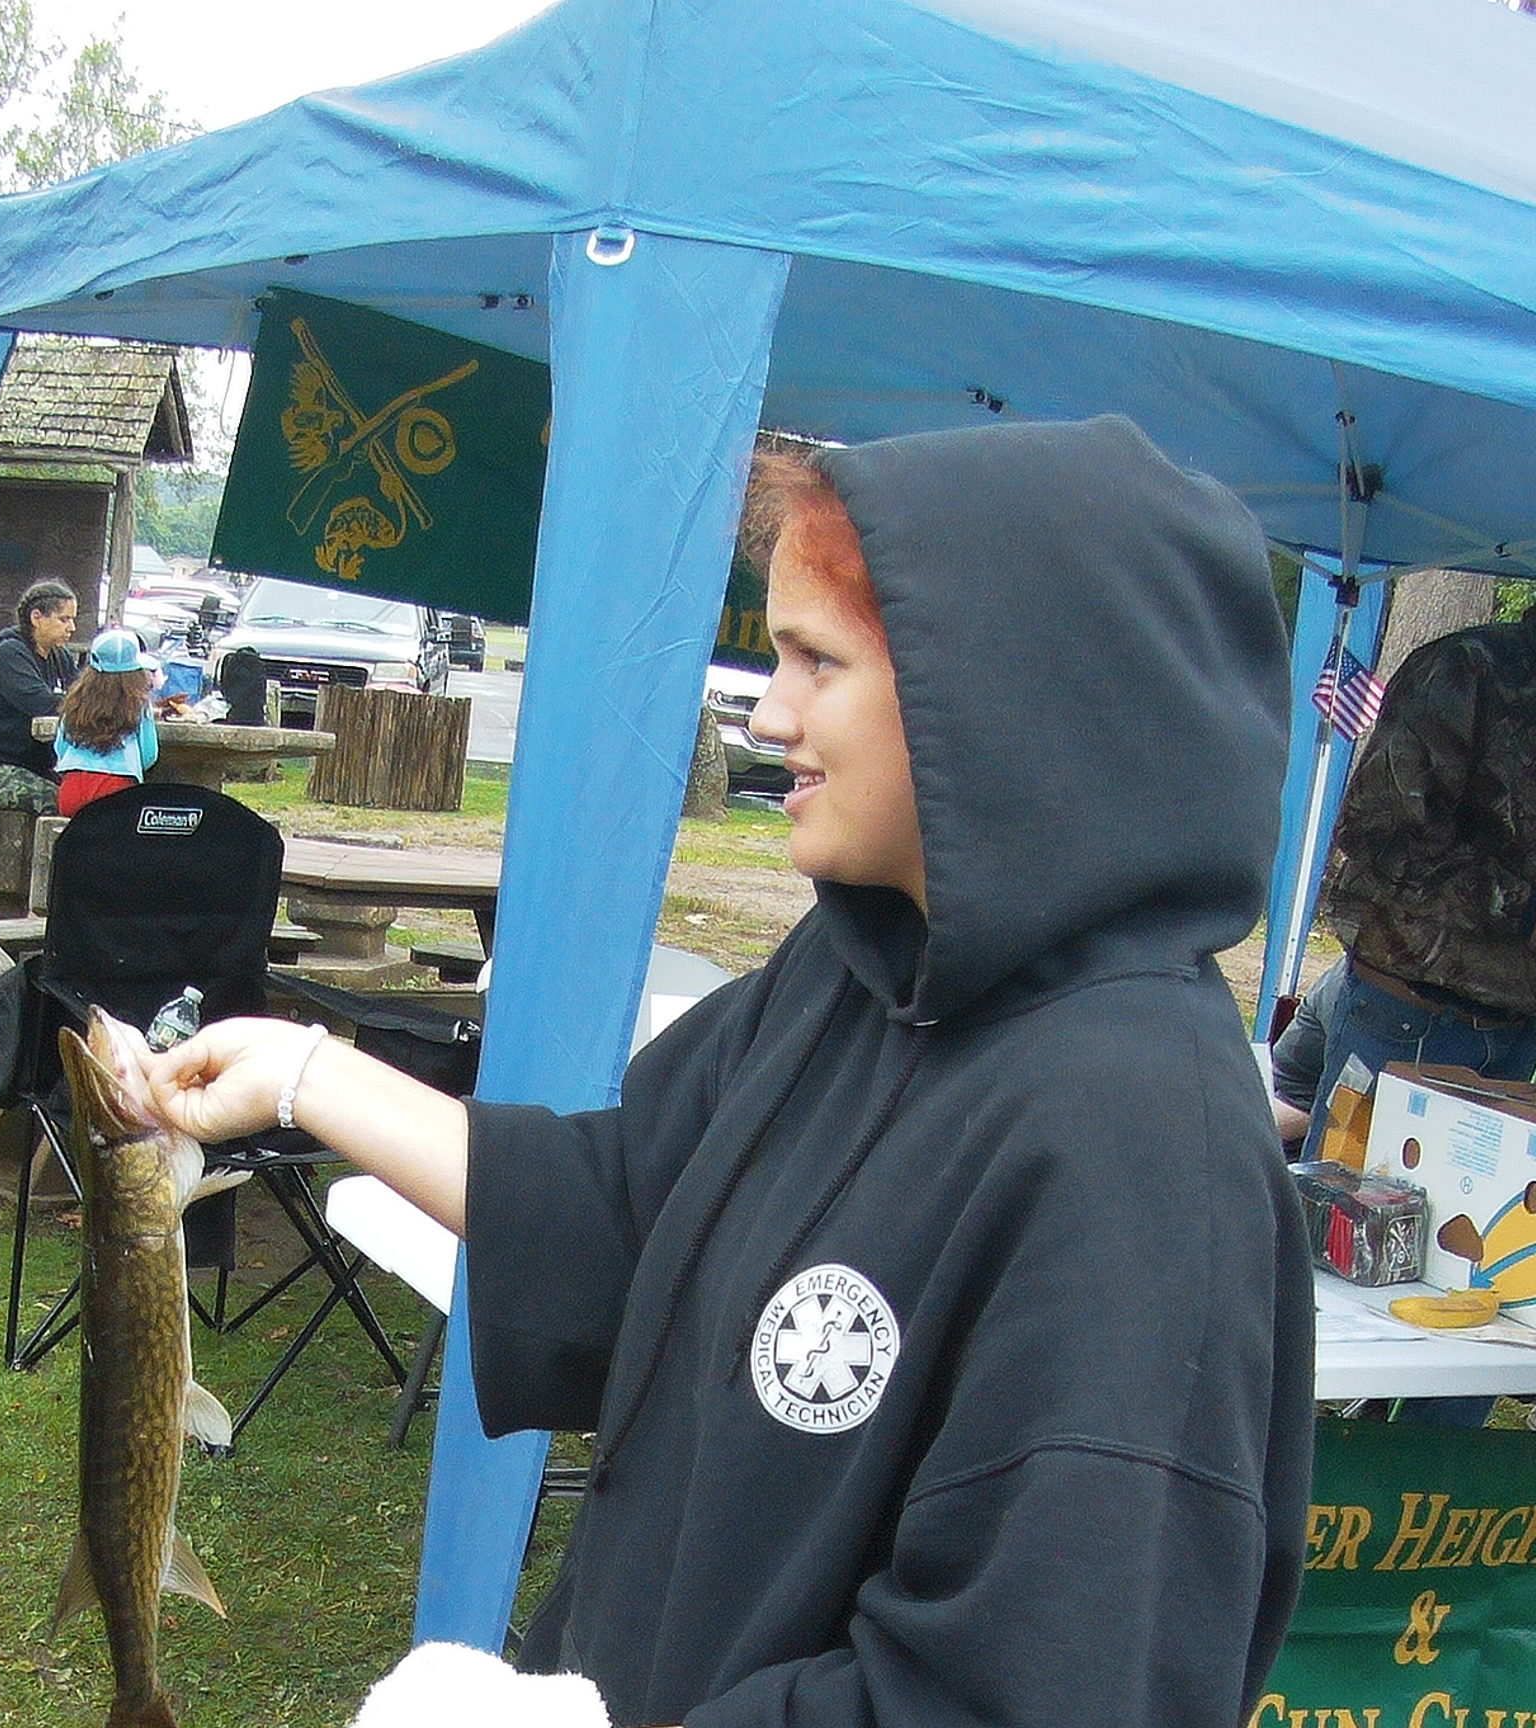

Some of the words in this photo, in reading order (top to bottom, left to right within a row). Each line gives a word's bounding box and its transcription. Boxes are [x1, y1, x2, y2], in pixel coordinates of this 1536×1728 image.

[144, 810, 188, 828] Coleman
[795, 1273, 892, 1358] EMERGENCY
[756, 1300, 786, 1395] MEDICAL
[774, 1371, 885, 1425] TECHNICIAN
[1304, 1504, 1372, 1570] ER
[1393, 1590, 1451, 1665] &
